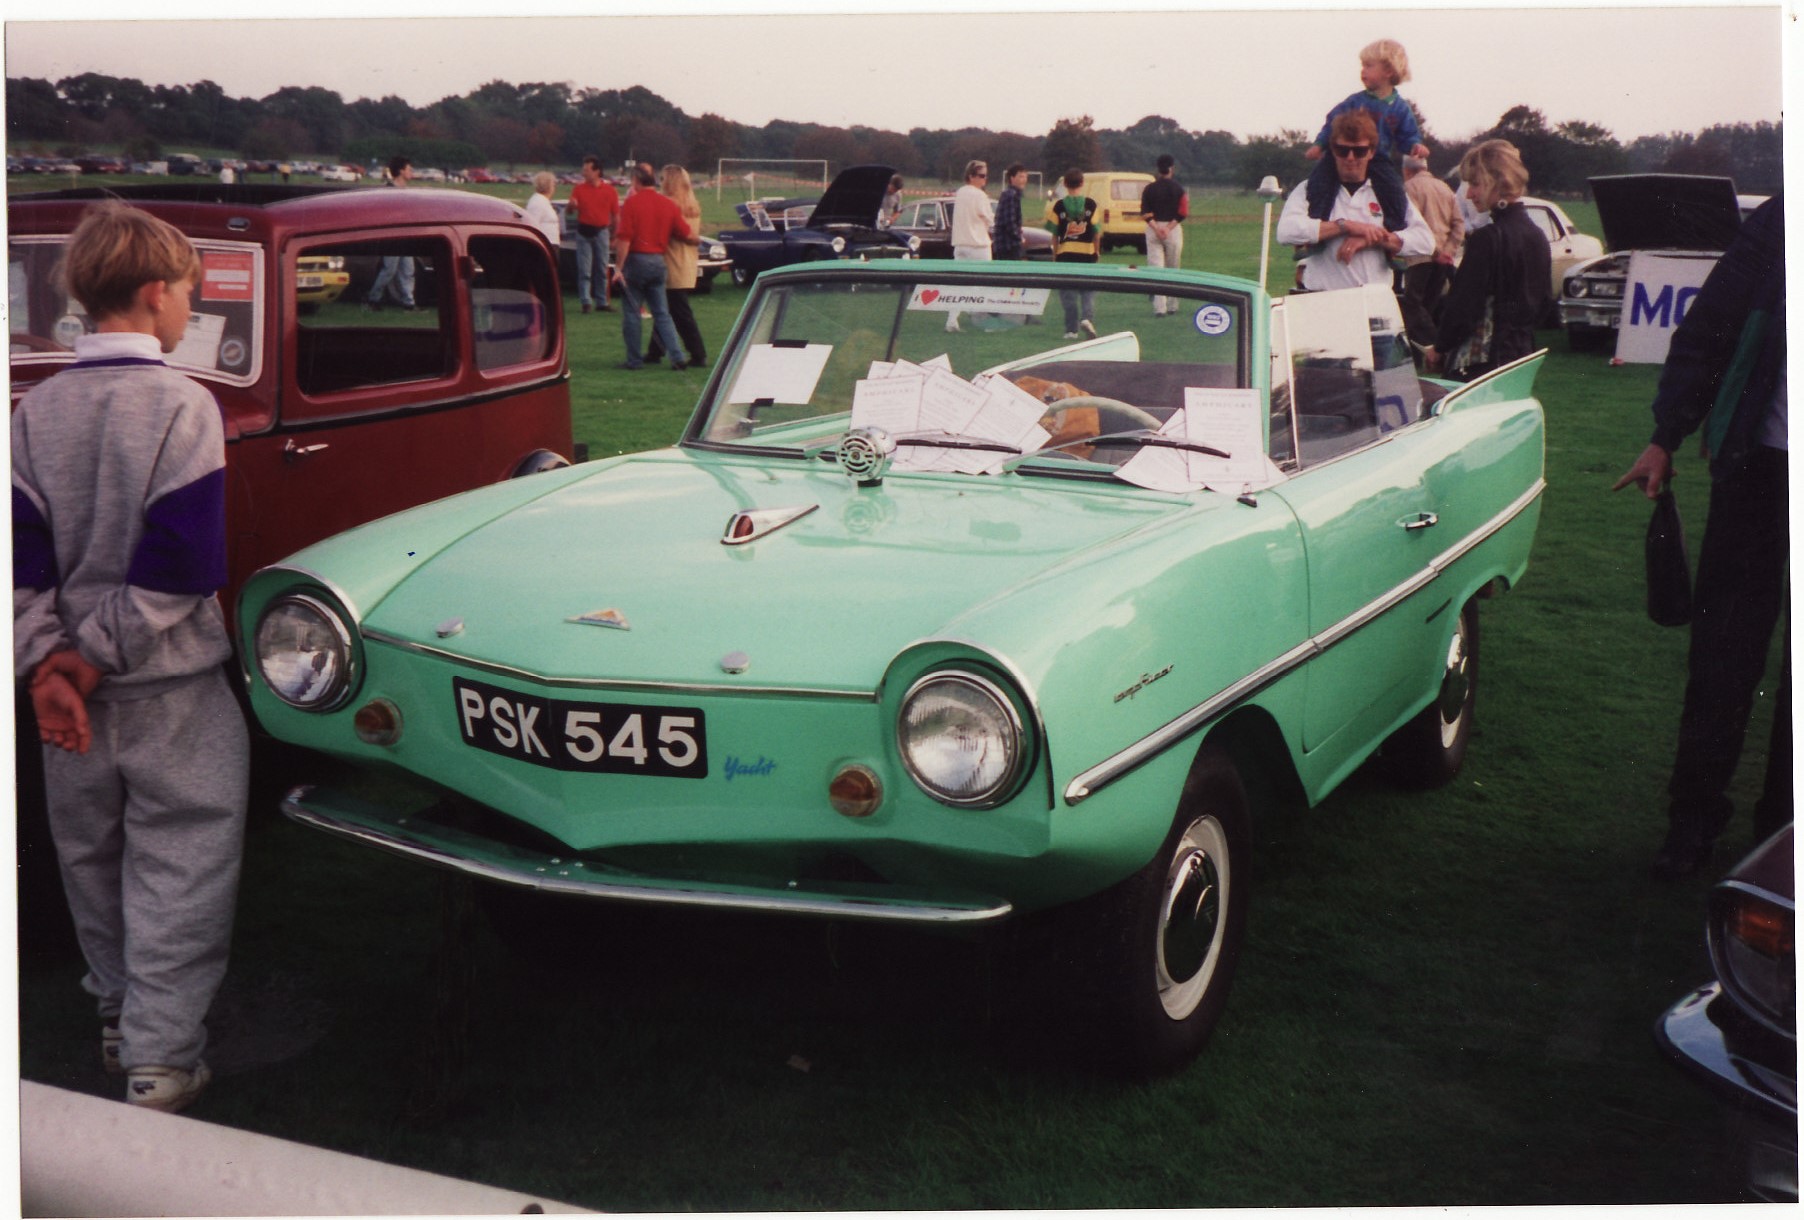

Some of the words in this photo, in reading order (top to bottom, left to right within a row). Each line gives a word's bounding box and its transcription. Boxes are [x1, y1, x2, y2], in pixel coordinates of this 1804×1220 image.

[914, 294, 919, 302] I
[937, 295, 985, 304] HELPING
[459, 687, 552, 759] PSK
[564, 710, 699, 768] 545
[723, 754, 777, 781] Yacht
